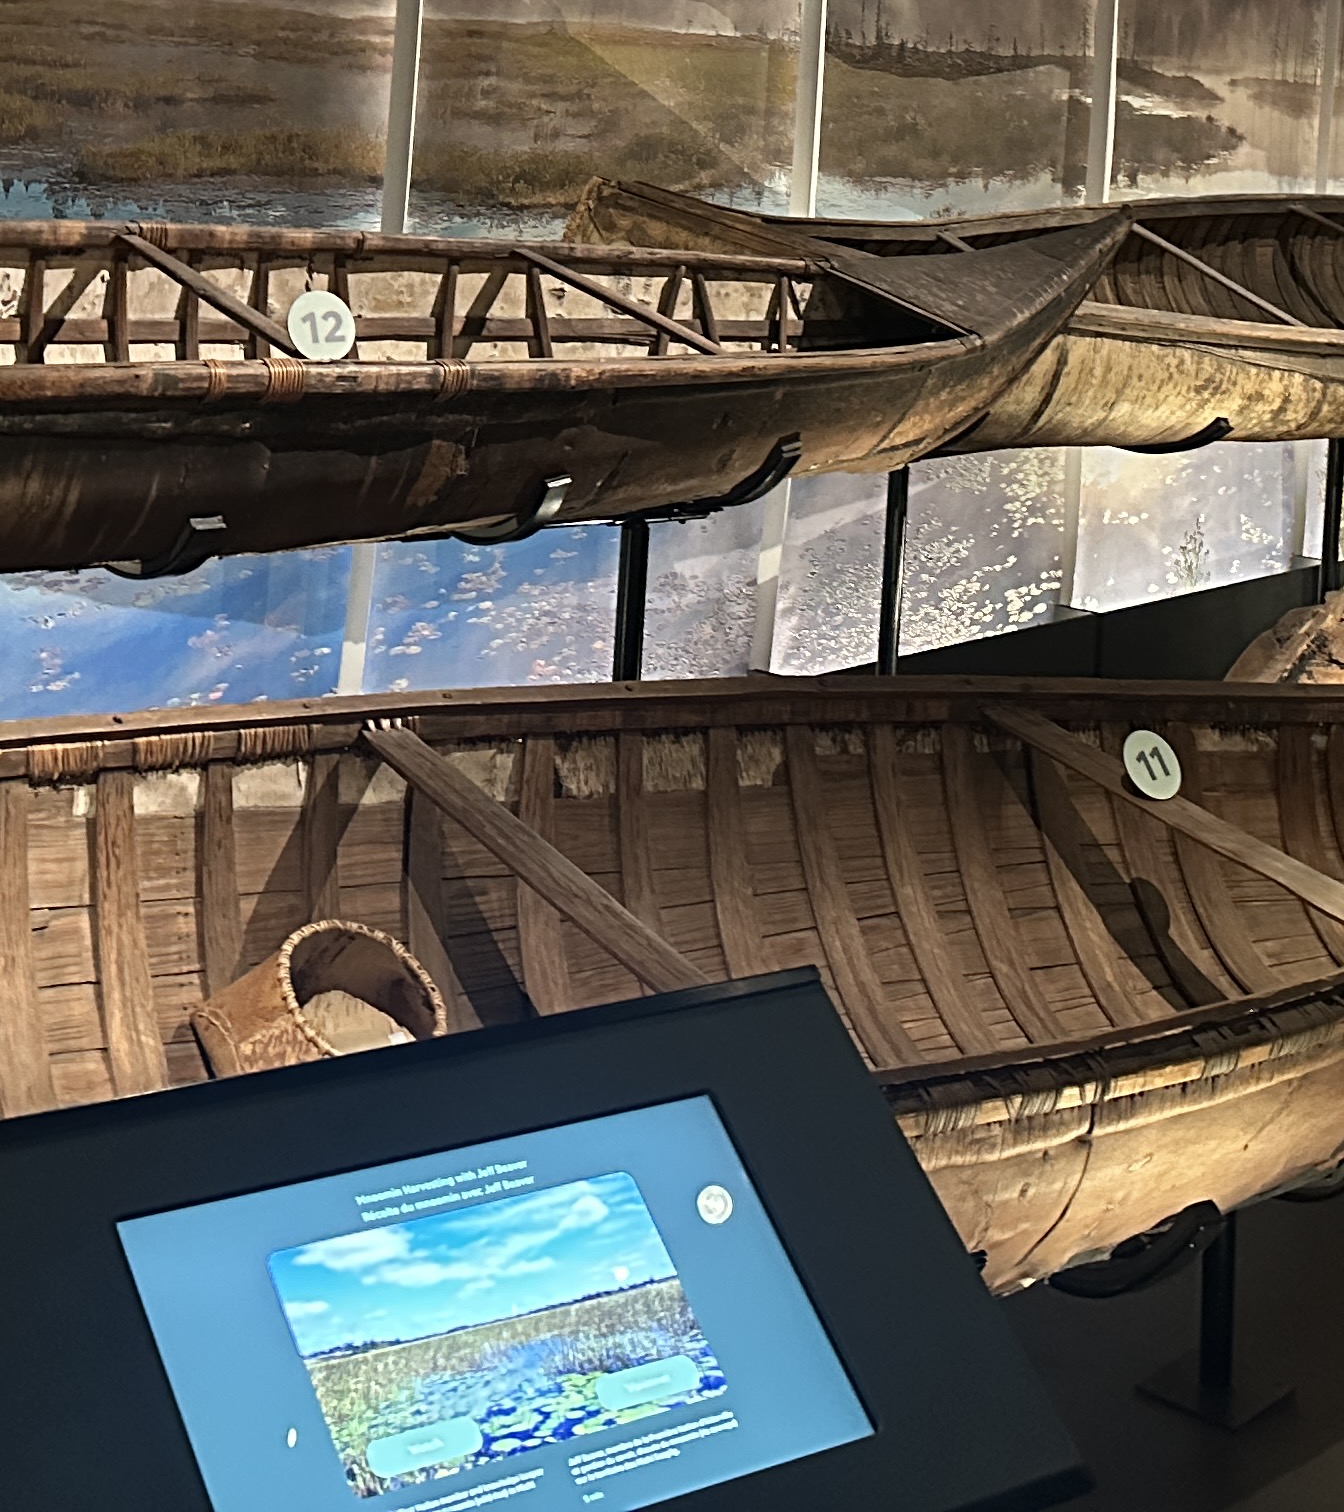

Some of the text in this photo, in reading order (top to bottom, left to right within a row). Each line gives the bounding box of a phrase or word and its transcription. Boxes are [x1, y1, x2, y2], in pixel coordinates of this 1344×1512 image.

[301, 310, 346, 344] 12
[1136, 746, 1171, 781] 11
[455, 1171, 477, 1183] with
[477, 1166, 495, 1178] Jeff
[484, 1181, 503, 1195] Jeff
